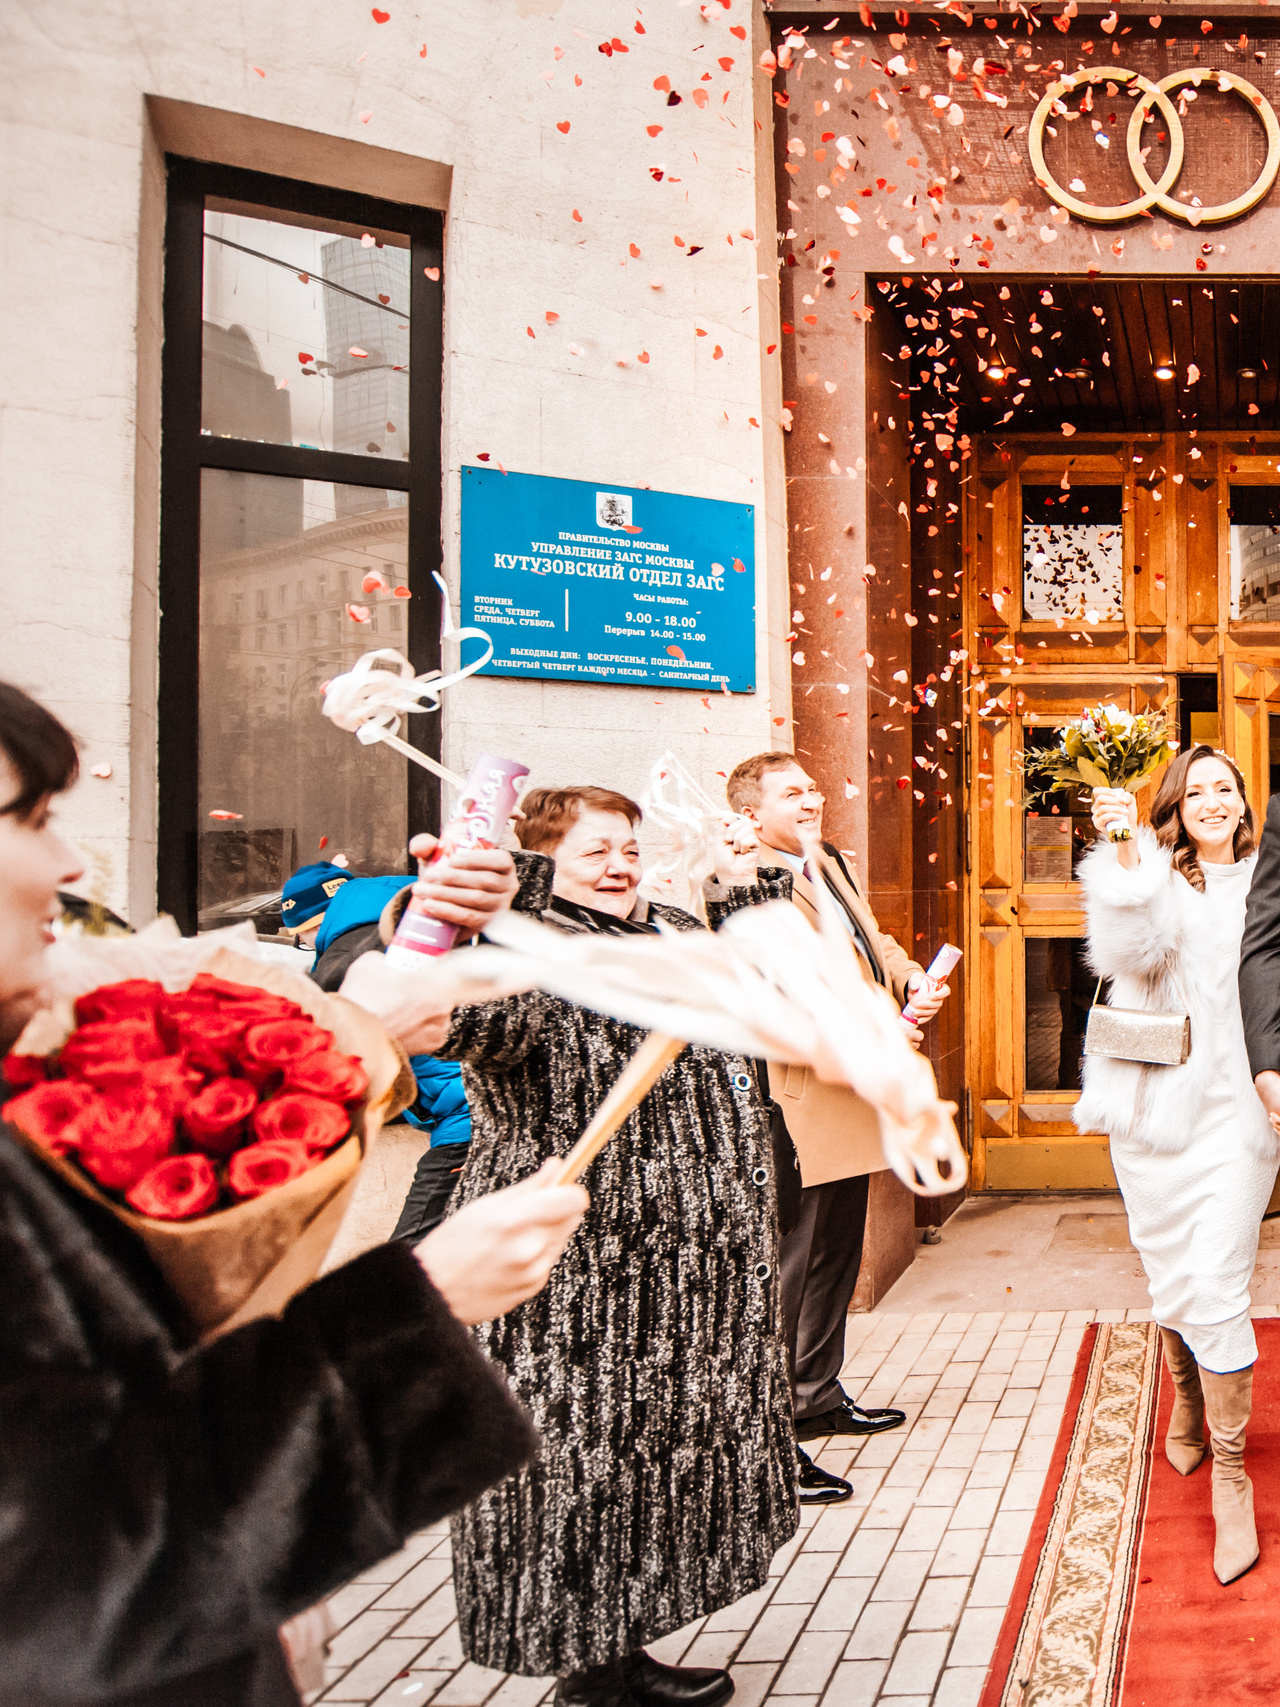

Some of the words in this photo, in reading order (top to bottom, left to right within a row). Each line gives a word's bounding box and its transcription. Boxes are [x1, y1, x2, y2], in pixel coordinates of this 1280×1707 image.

[558, 531, 631, 548] ПРАВИТЕЛЬСТВО
[632, 540, 670, 553] МОСКВЫ
[530, 541, 613, 561] УПРАВЛЕНИЕ
[614, 550, 643, 564] ЗАГС
[645, 554, 695, 570] МОСКВЫ
[493, 553, 625, 581] КУТУЗОВСКИЙ
[629, 567, 683, 588] ОТДЕЛ
[686, 573, 725, 592] ЗАГС
[474, 595, 514, 606] ВТОРНИК
[633, 592, 656, 602] ЧАСЫ
[656, 595, 690, 606] РАБОТЫ:
[505, 607, 541, 618] ЧЕТВЕРГ
[625, 611, 653, 624] 9.00
[663, 615, 697, 629] 18.00
[519, 618, 556, 628] СУББОТА
[604, 624, 646, 637] Перерыв
[650, 629, 675, 639] 14.00
[682, 632, 707, 642] 15.00
[510, 647, 559, 658] ВЫХОДНЫЕ
[560, 651, 581, 660] ДНИ:
[587, 652, 649, 666] ВОСКРЕСЕНЬЕ,
[651, 657, 715, 671] ПОНЕДЕЛЬНИК,
[491, 659, 541, 669] ЧЕТВЕРТЫЙ
[542, 662, 577, 672] ЧЕТВЕРГ
[577, 665, 616, 675] КАЖДОГО
[616, 667, 648, 677] МЕСЯЦА
[658, 670, 710, 682] САНИТАРНЫЙ
[710, 674, 731, 683] ДЕНЬ
